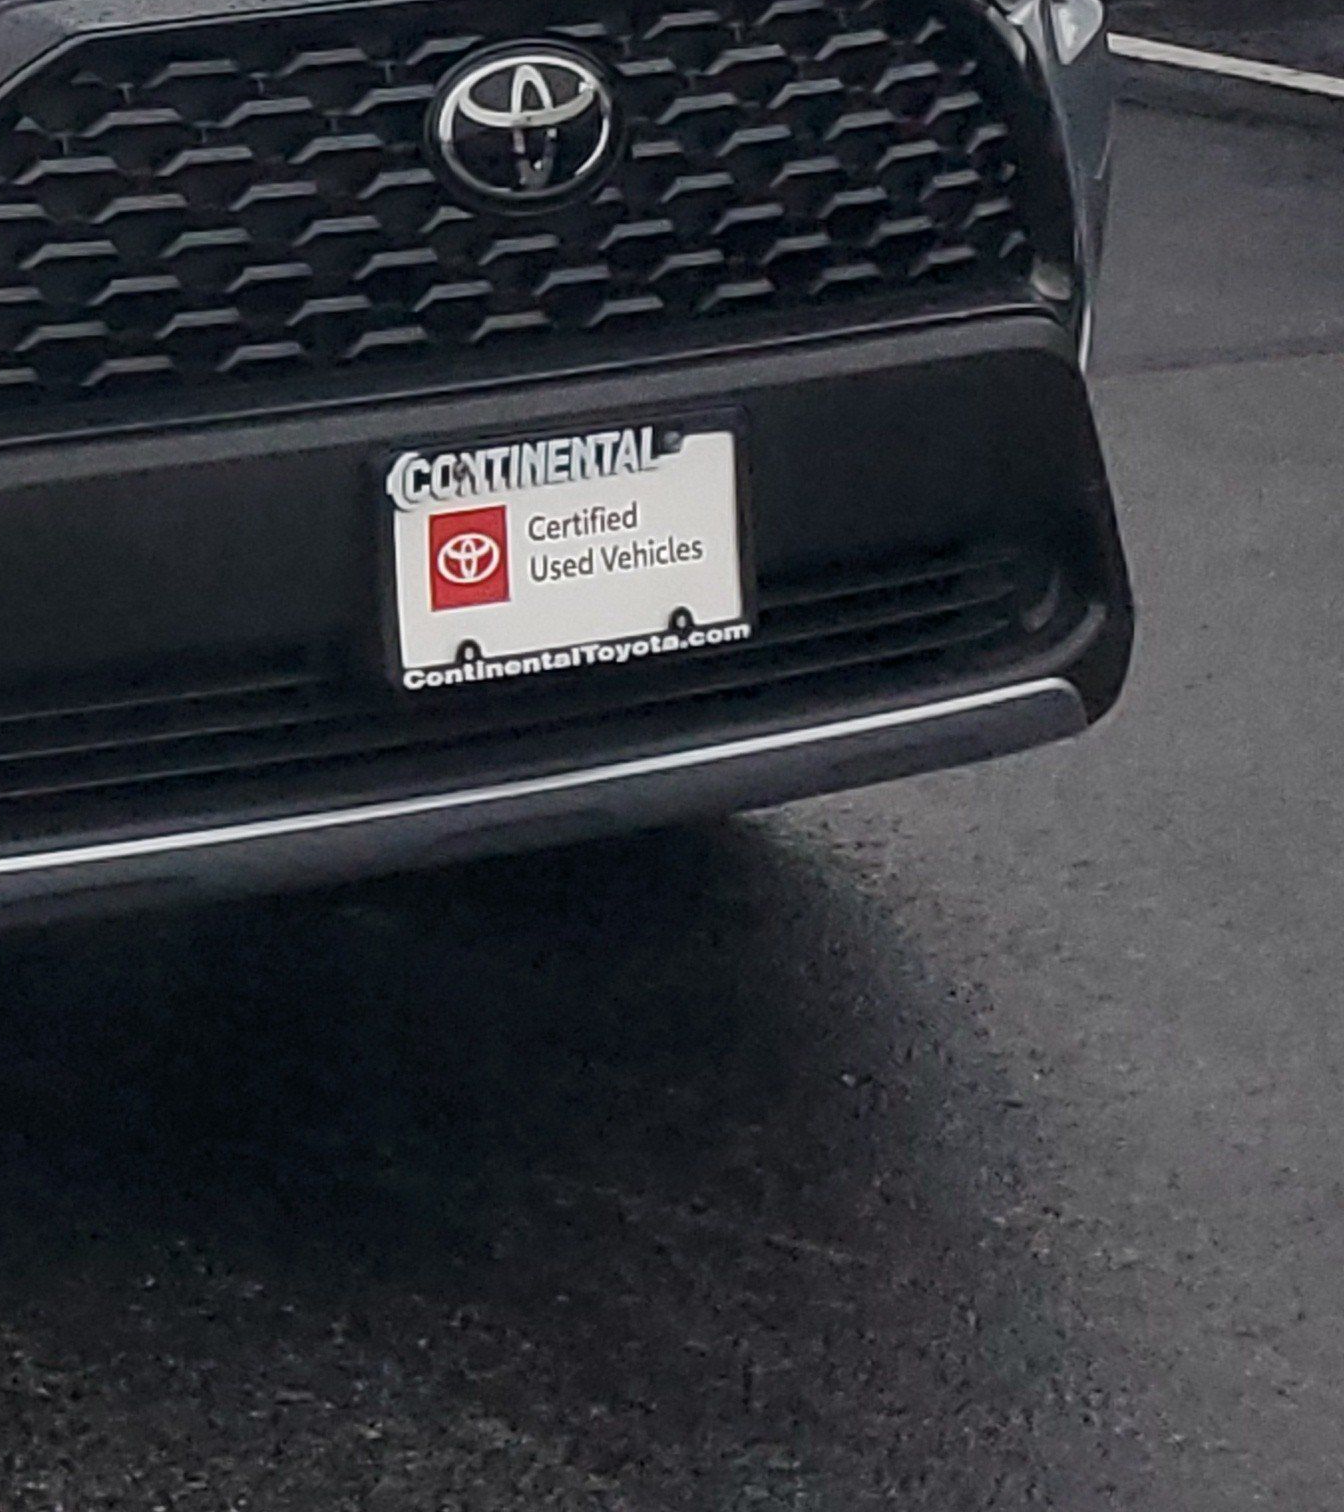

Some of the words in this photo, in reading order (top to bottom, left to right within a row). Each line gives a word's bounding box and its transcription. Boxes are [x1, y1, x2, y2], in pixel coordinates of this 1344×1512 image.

[403, 426, 655, 503] CONTINENTAL
[527, 501, 639, 542] Certified
[529, 547, 594, 582] Used
[600, 535, 704, 572] Vehicles
[402, 622, 751, 690] ContinentalToyota.com
